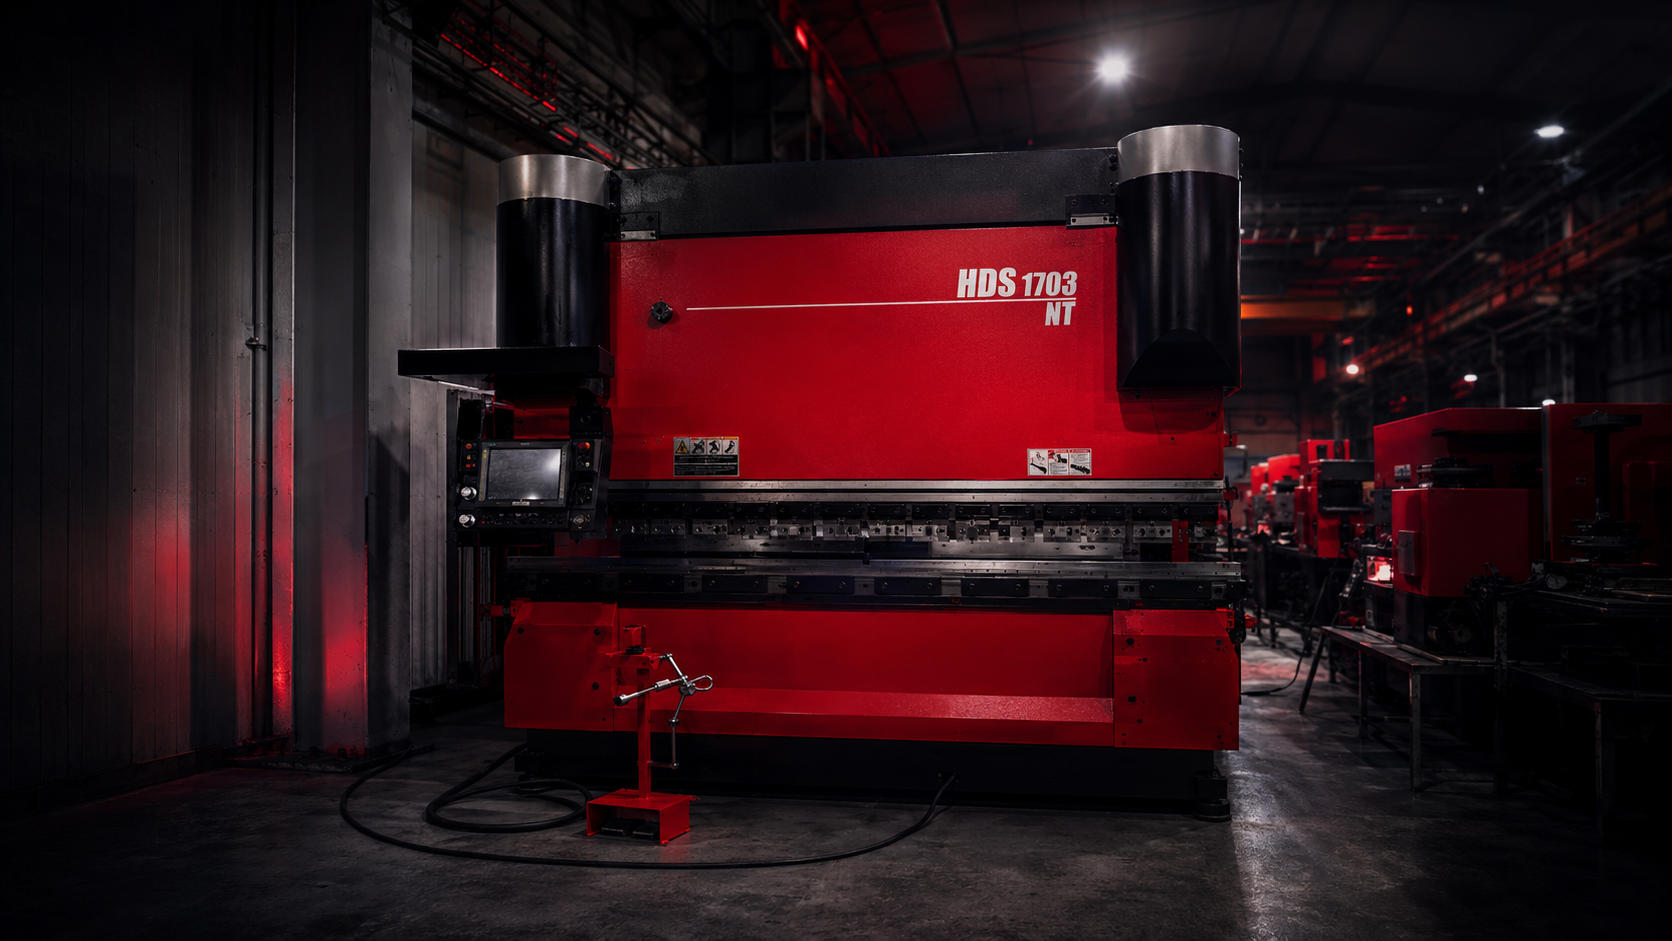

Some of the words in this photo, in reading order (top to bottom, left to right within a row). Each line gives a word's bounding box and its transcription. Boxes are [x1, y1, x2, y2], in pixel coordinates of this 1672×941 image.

[957, 267, 1017, 298] HDS
[1021, 271, 1078, 297] 1703
[1045, 301, 1076, 326] NT
